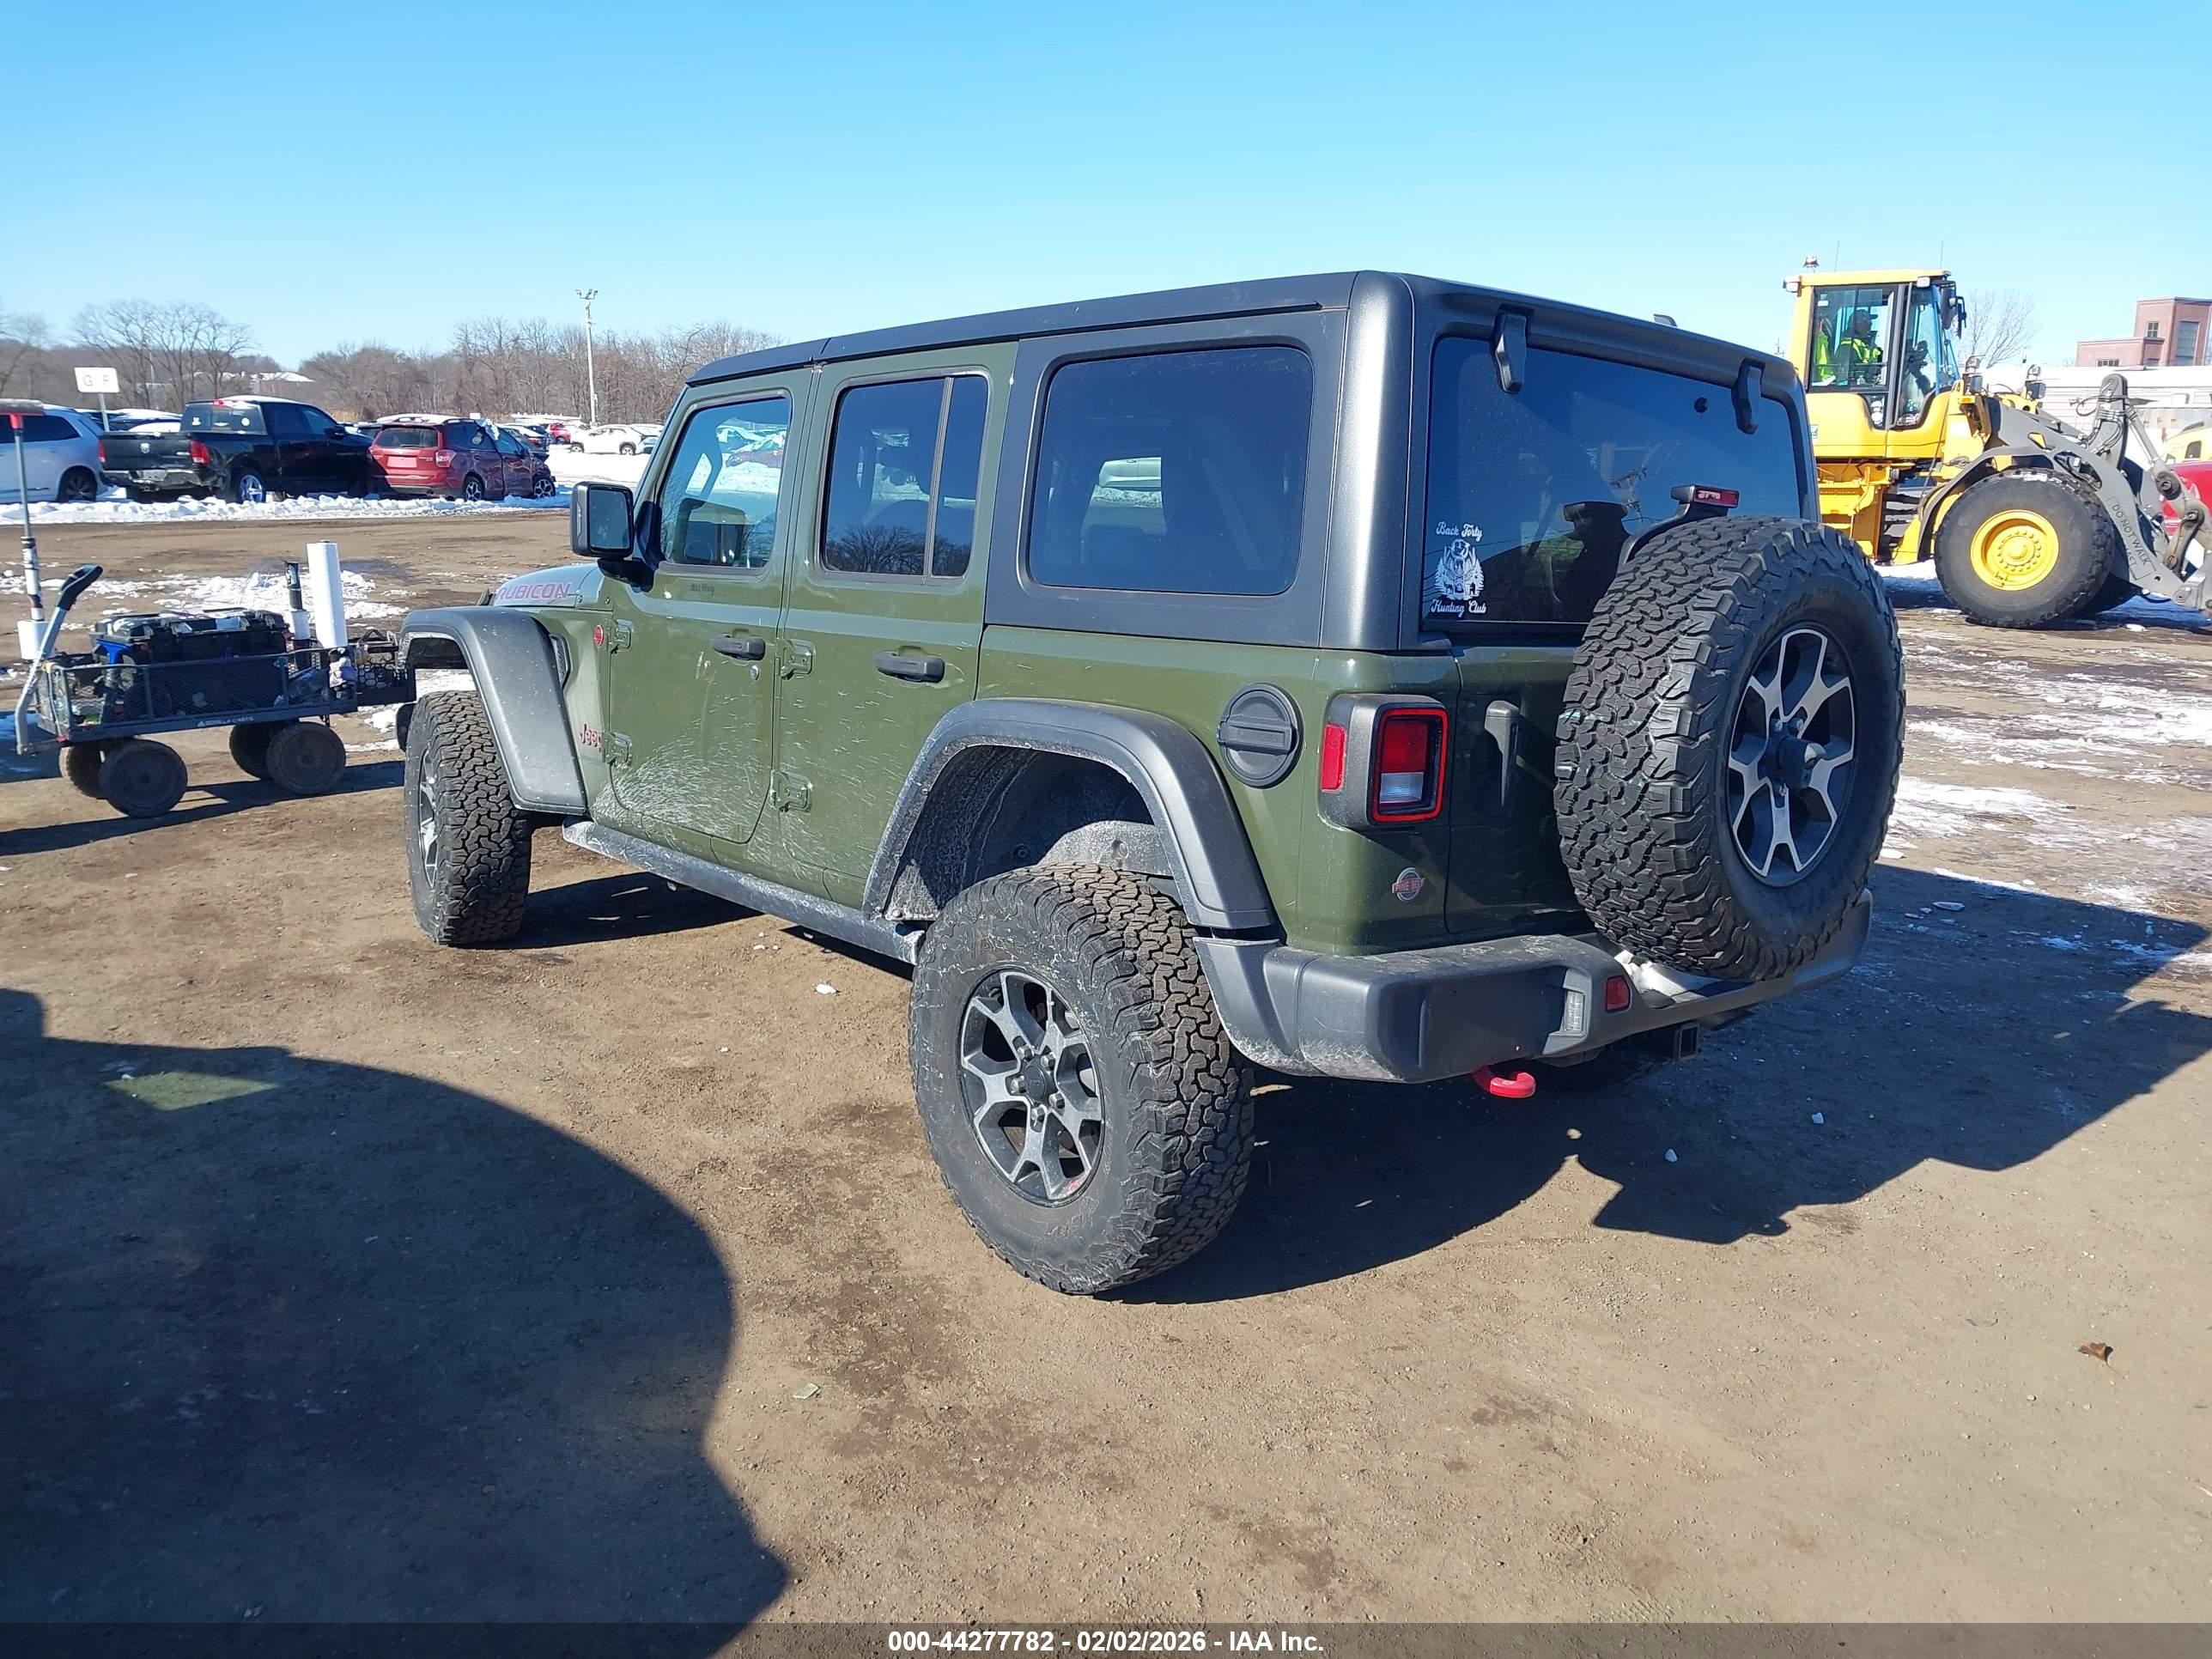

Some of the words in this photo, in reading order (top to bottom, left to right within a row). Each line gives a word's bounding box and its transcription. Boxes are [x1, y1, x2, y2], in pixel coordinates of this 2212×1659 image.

[1436, 521, 1460, 536] Back
[1462, 523, 1483, 542] Forty
[2112, 504, 2124, 519] DO
[2121, 519, 2136, 538] NOT
[2132, 538, 2152, 565] WALK
[497, 583, 572, 599] RUBICON
[1431, 599, 1465, 617] Hunting
[1468, 600, 1487, 614] Club
